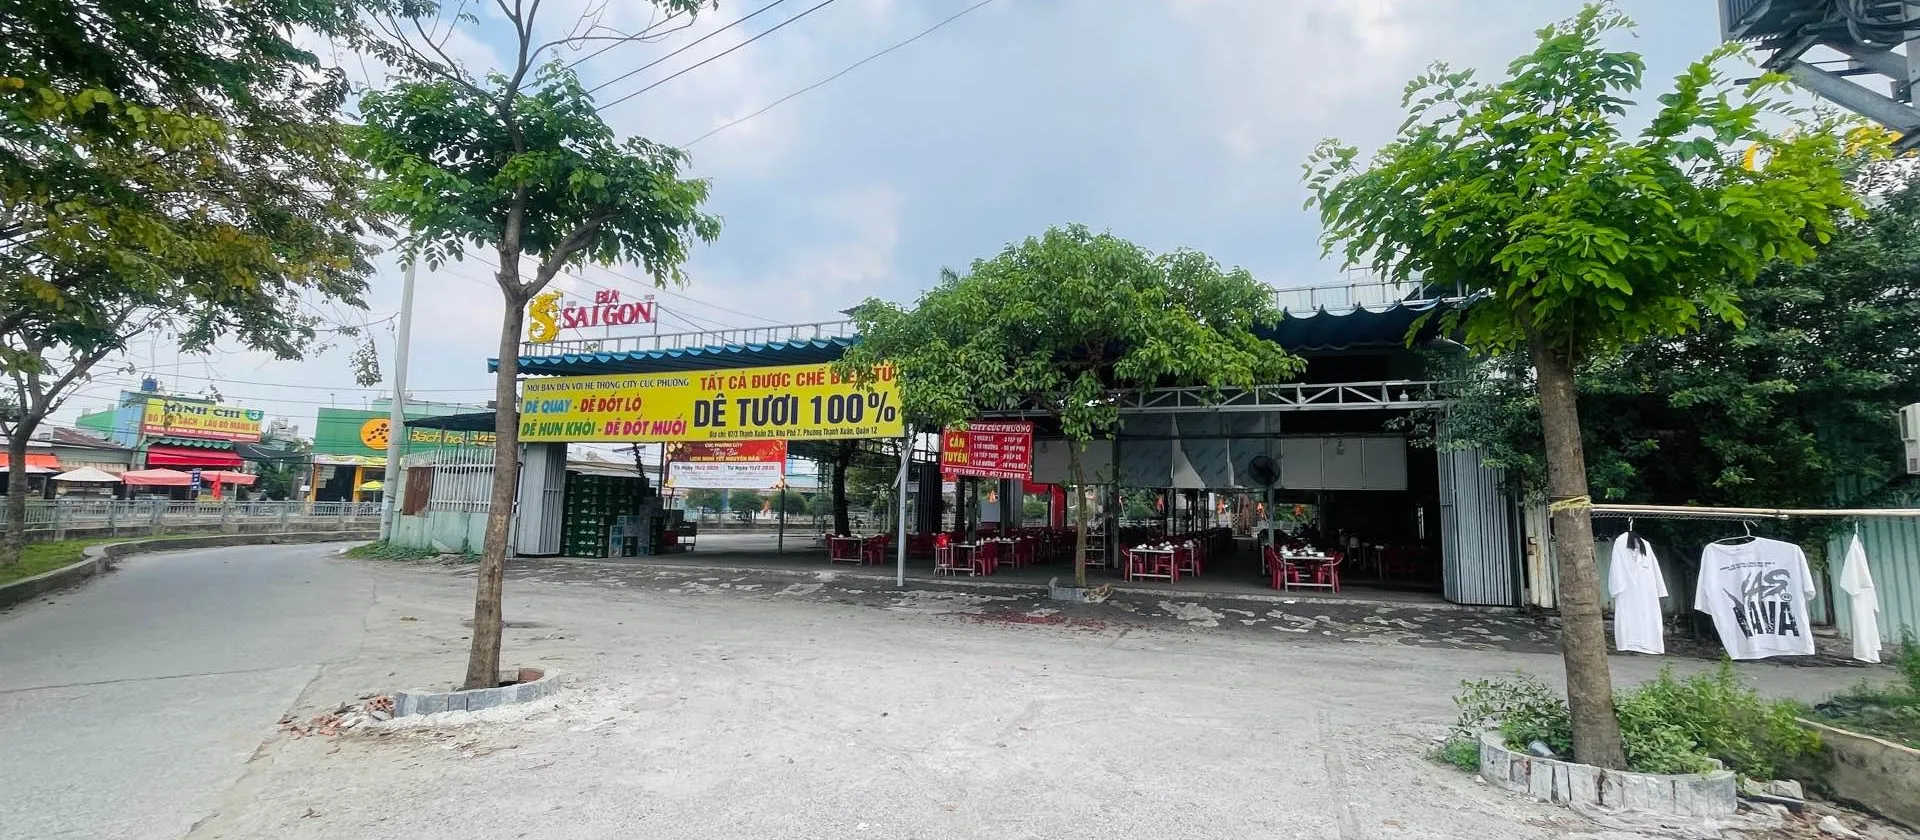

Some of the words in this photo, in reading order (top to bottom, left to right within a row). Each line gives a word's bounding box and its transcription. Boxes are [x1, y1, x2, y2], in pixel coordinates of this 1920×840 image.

[595, 290, 620, 304] BIA
[622, 380, 638, 388] CITY
[700, 371, 724, 391] TẤT
[728, 370, 747, 389] CẢ
[751, 371, 790, 391] ĐƯỢC
[796, 366, 826, 386] CHẾ
[541, 399, 572, 413] QUAY
[580, 395, 596, 412] DÊ
[597, 391, 624, 412] ĐỐT
[693, 393, 727, 427] DÊ
[736, 393, 799, 427] TƯƠI
[810, 391, 896, 424] 100%
[521, 418, 537, 436] DÊ
[538, 421, 563, 436] HUN
[565, 417, 596, 436] KHÓI
[604, 417, 621, 435] DÊ
[623, 413, 649, 435] ĐỐT
[650, 412, 687, 435] MUỐI
